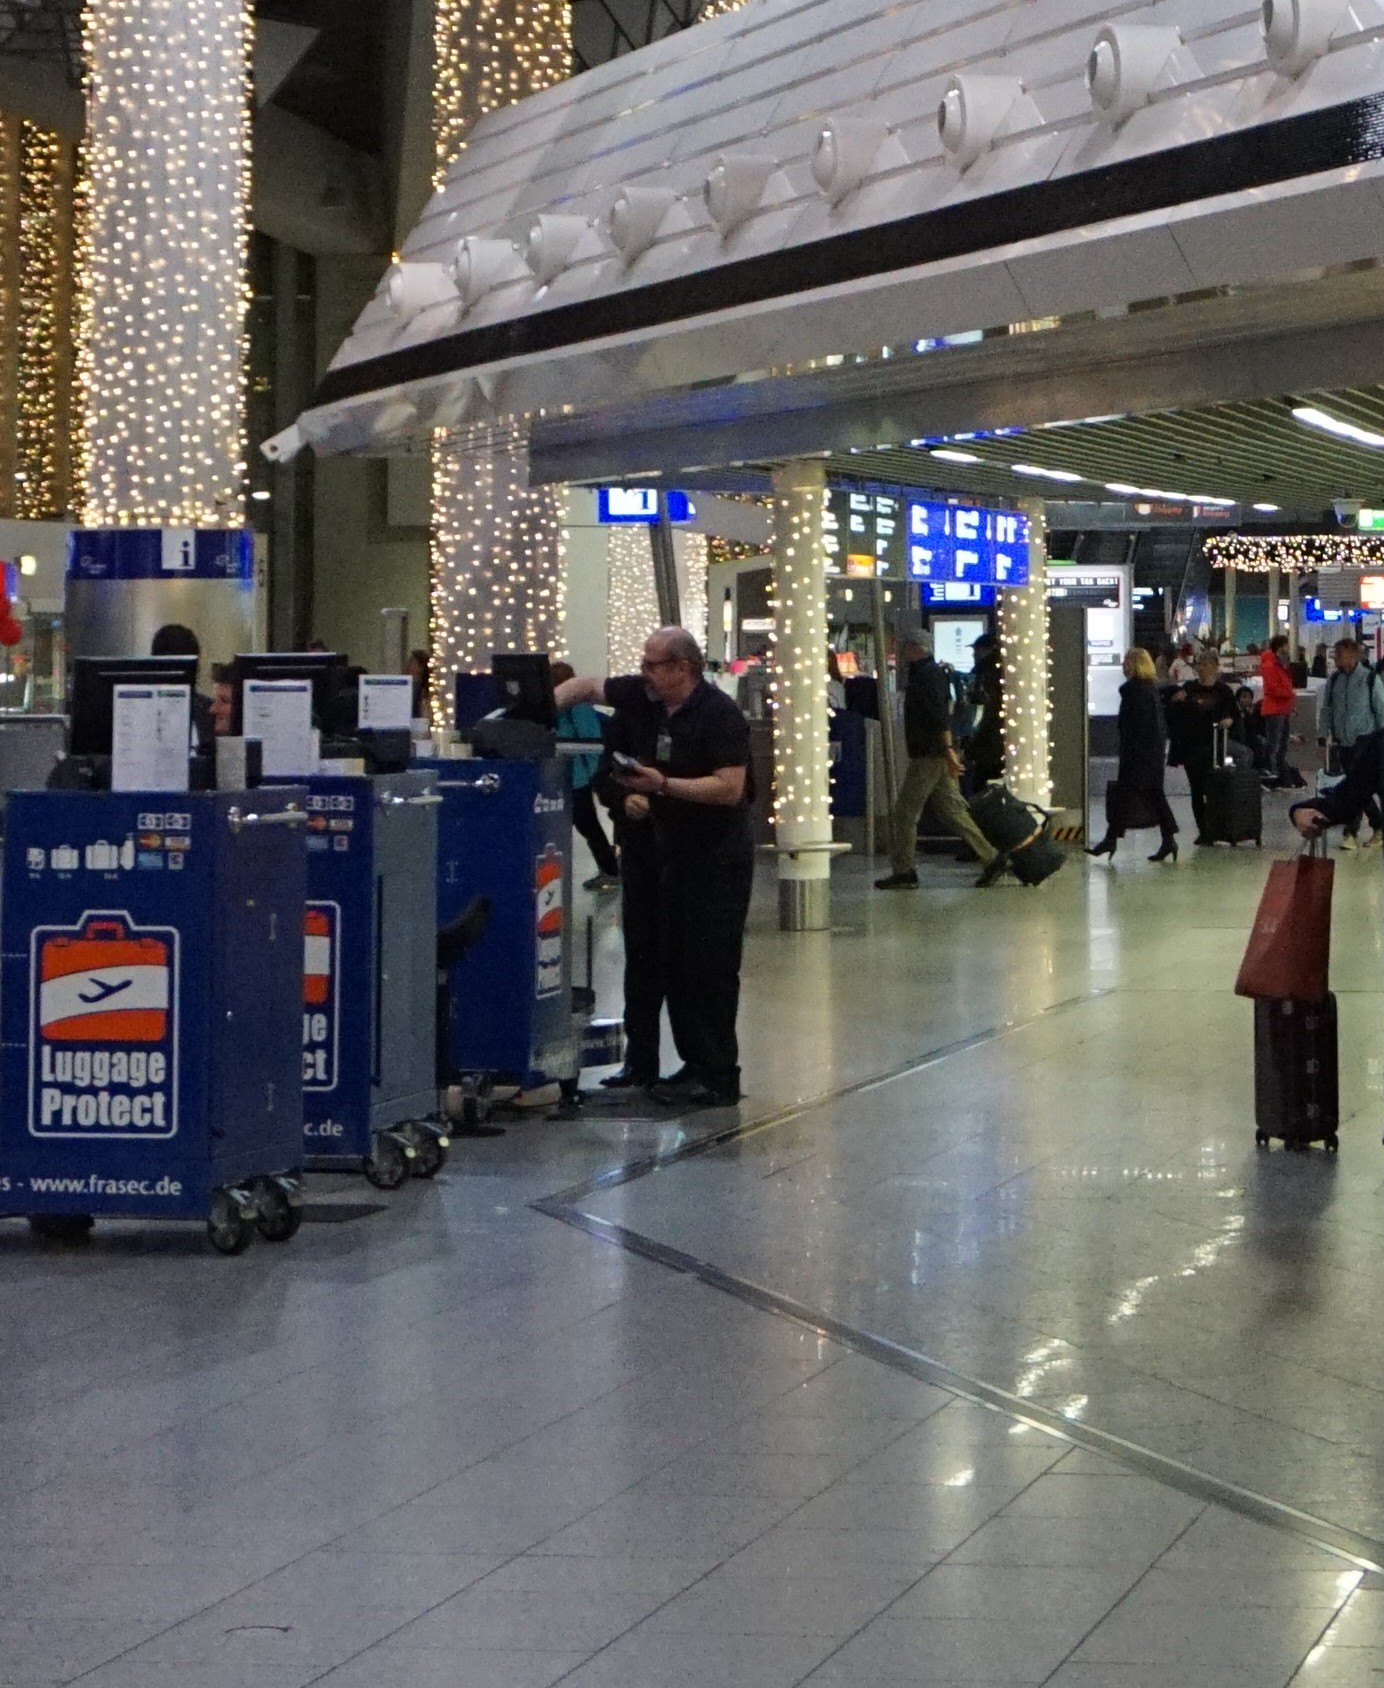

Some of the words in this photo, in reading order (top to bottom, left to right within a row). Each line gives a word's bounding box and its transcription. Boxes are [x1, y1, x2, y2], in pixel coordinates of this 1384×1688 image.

[41, 1044, 167, 1088] Luggage
[41, 1087, 167, 1128] Protect
[30, 1173, 183, 1197] www.frasec.de
